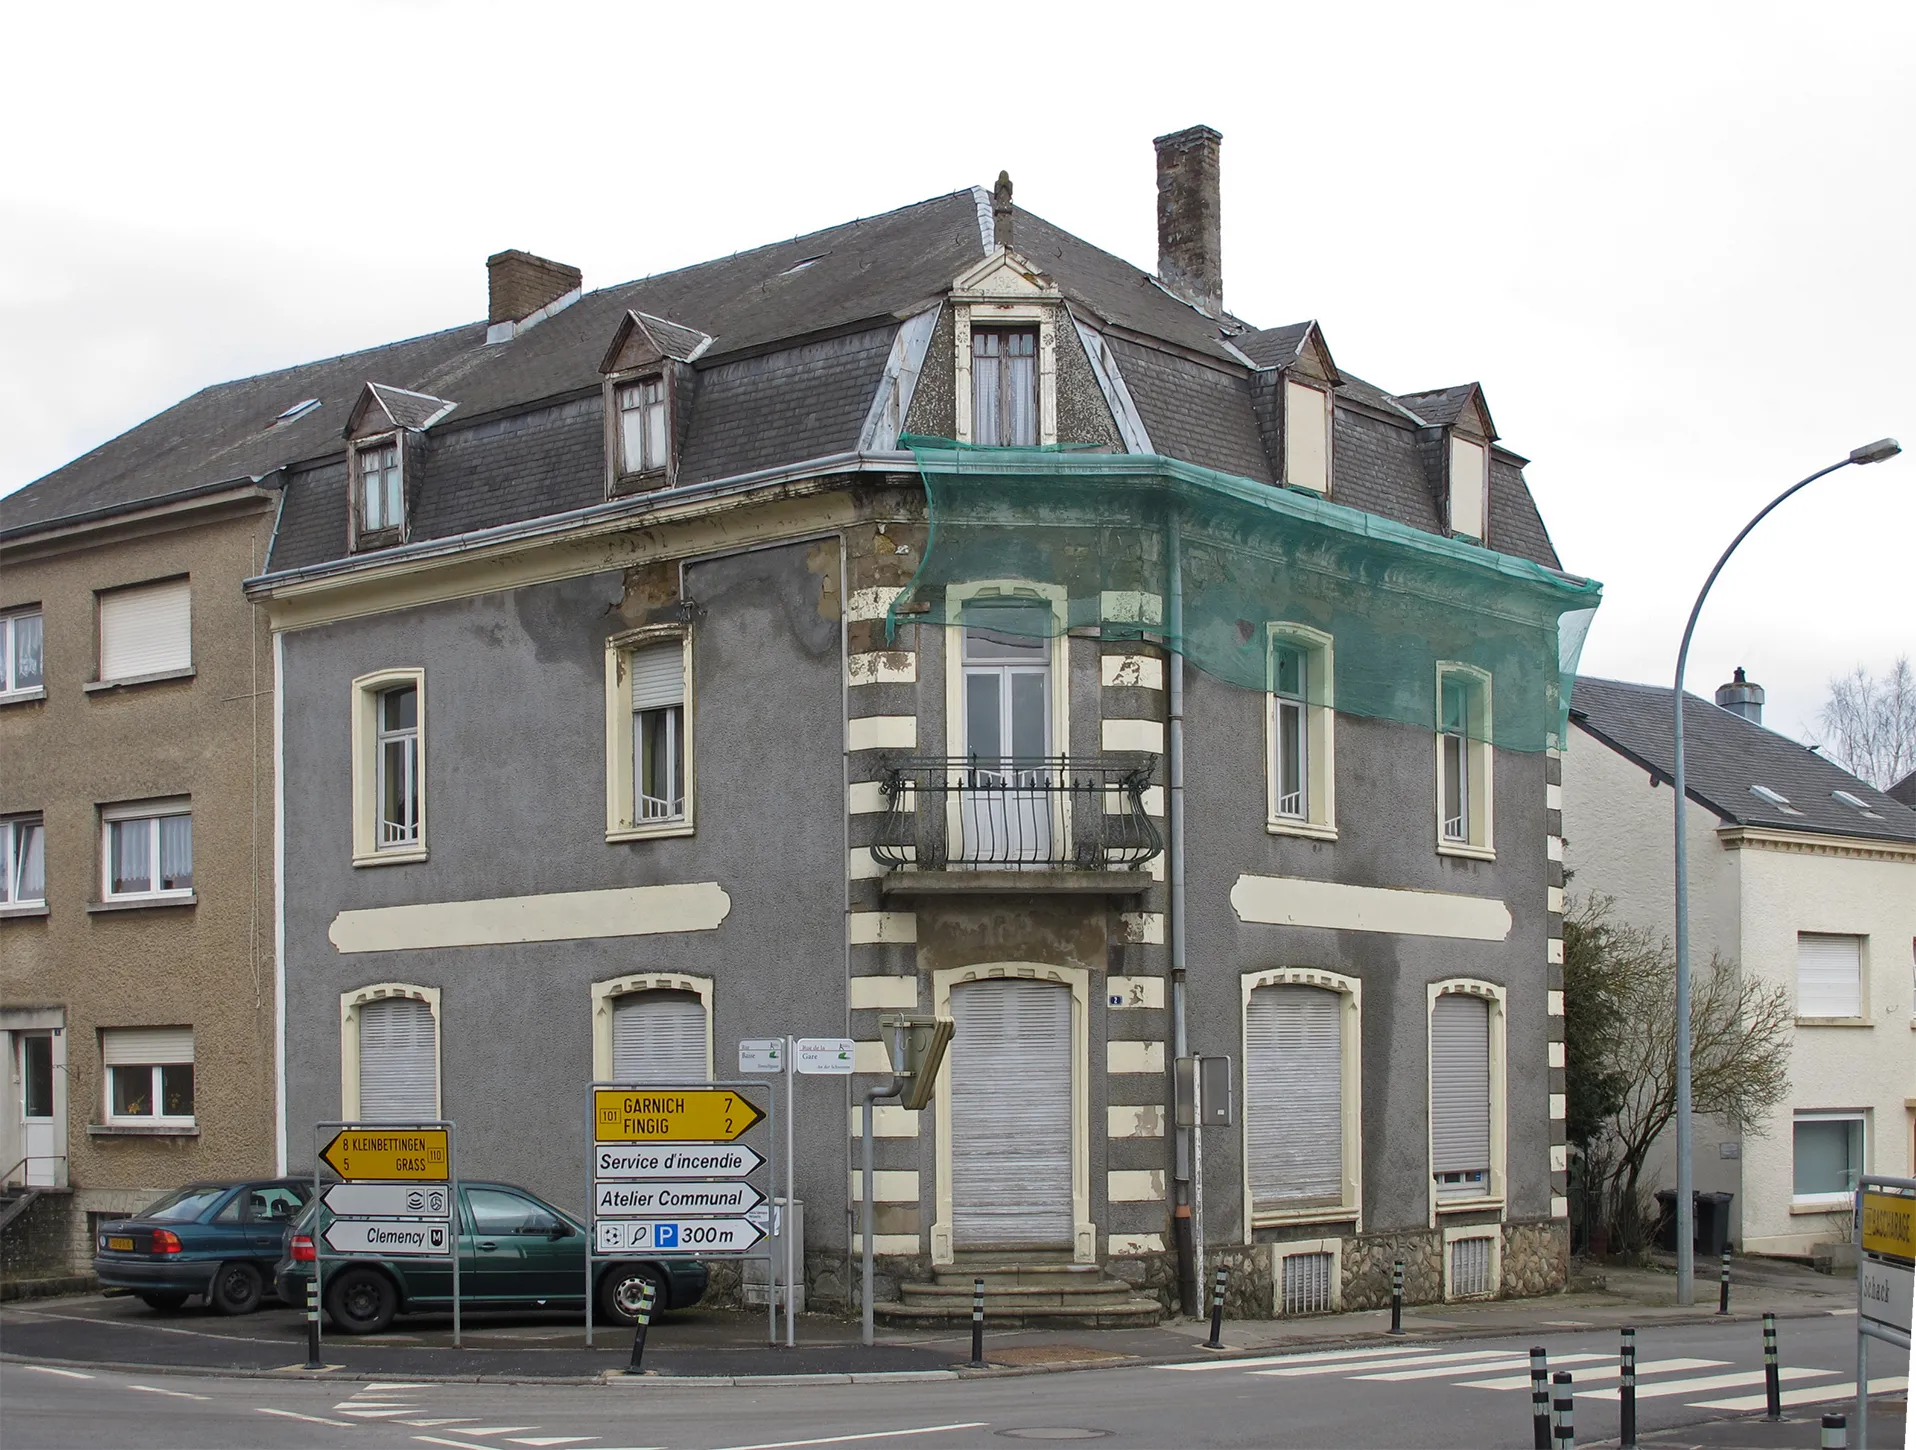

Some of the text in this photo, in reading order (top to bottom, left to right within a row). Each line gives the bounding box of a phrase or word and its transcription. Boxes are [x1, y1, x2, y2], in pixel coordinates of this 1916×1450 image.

[1113, 996, 1118, 1004] 2
[624, 1098, 733, 1114] GARNICH 7
[603, 1111, 617, 1121] 101
[624, 1118, 733, 1134] FINGIG 2
[343, 1138, 426, 1151] 8 KLEINBETTINGEN
[430, 1150, 442, 1161] 110
[600, 1152, 742, 1170] Service d'incendie
[344, 1158, 426, 1171] 5 GRASS
[600, 1190, 742, 1207] Atelier Communal
[1872, 1209, 1911, 1243] BASCHARAGE
[367, 1227, 425, 1247] Clemency
[660, 1227, 733, 1245] P 300 m
[1863, 1275, 1890, 1303] Schack
